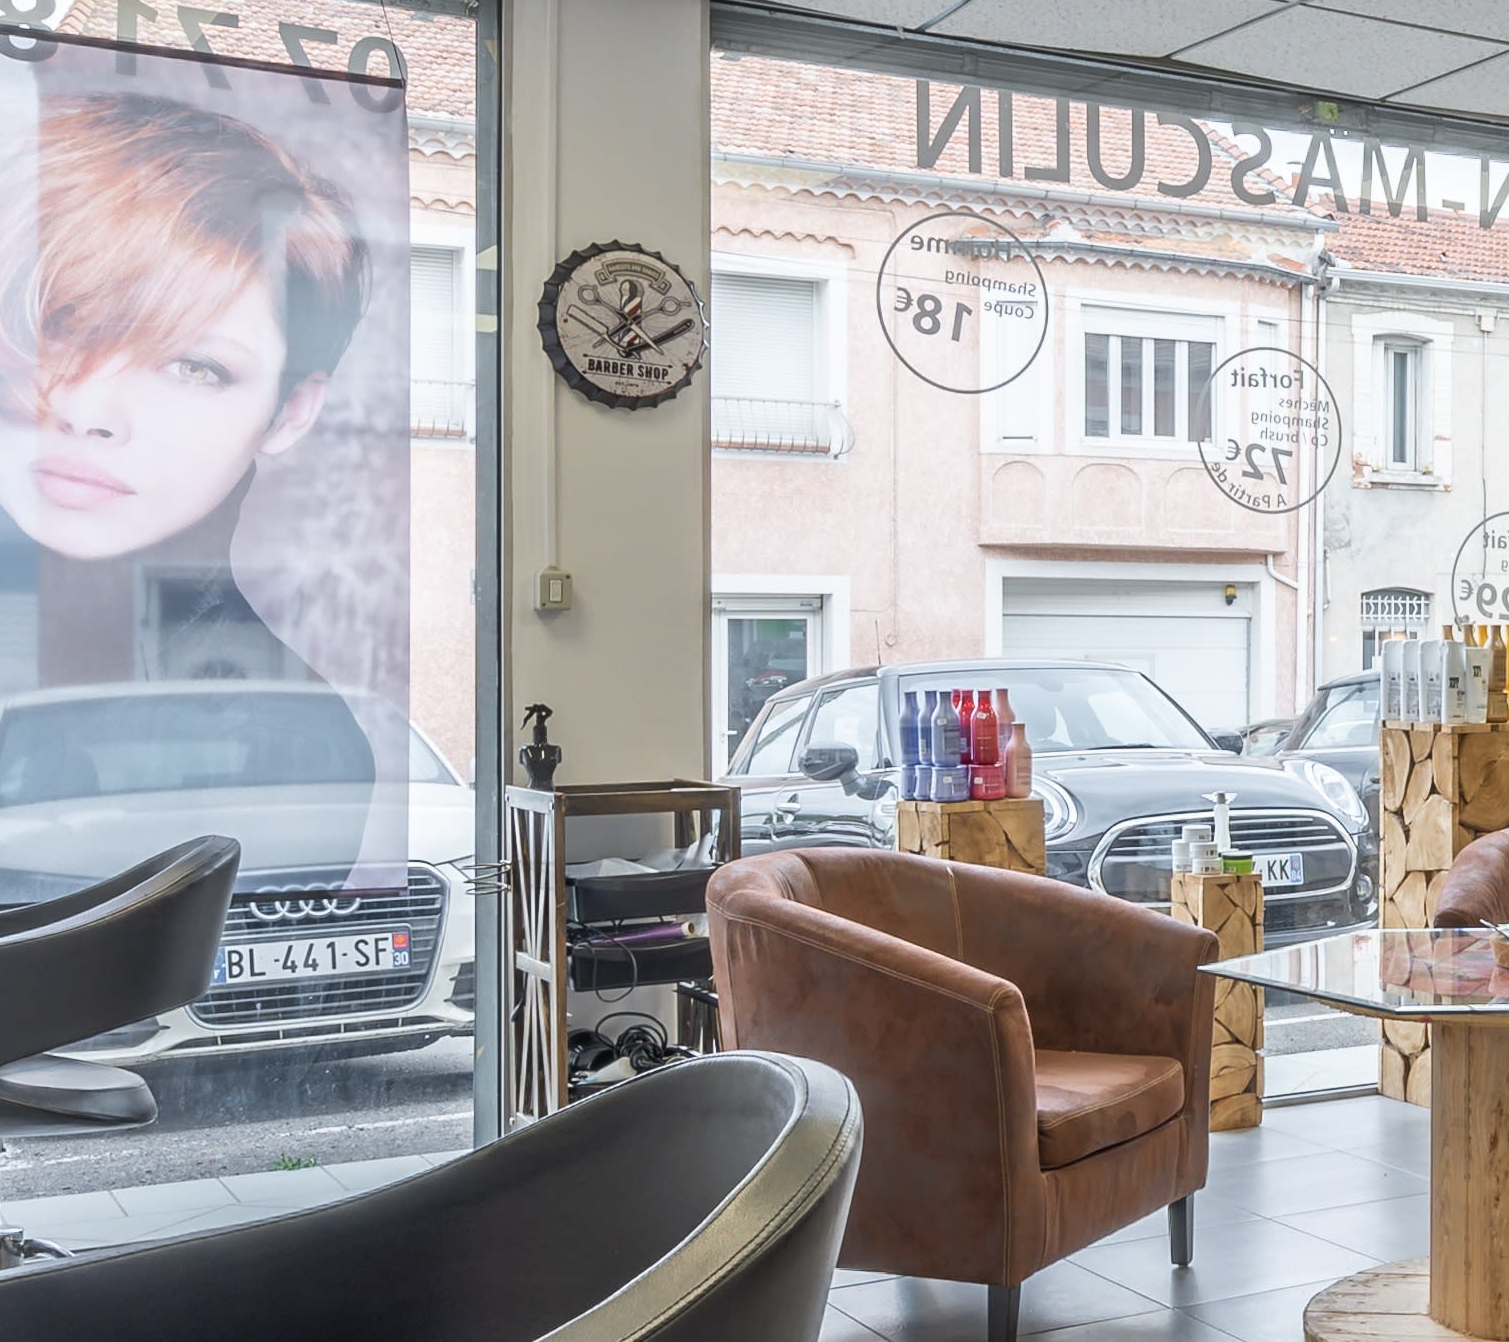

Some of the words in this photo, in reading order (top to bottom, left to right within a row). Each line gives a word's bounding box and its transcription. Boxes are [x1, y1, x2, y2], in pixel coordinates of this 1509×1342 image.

[588, 358, 634, 377] BARBER
[638, 365, 669, 381] SHOP
[227, 937, 389, 979] BL-441-SF
[394, 951, 409, 966] 30
